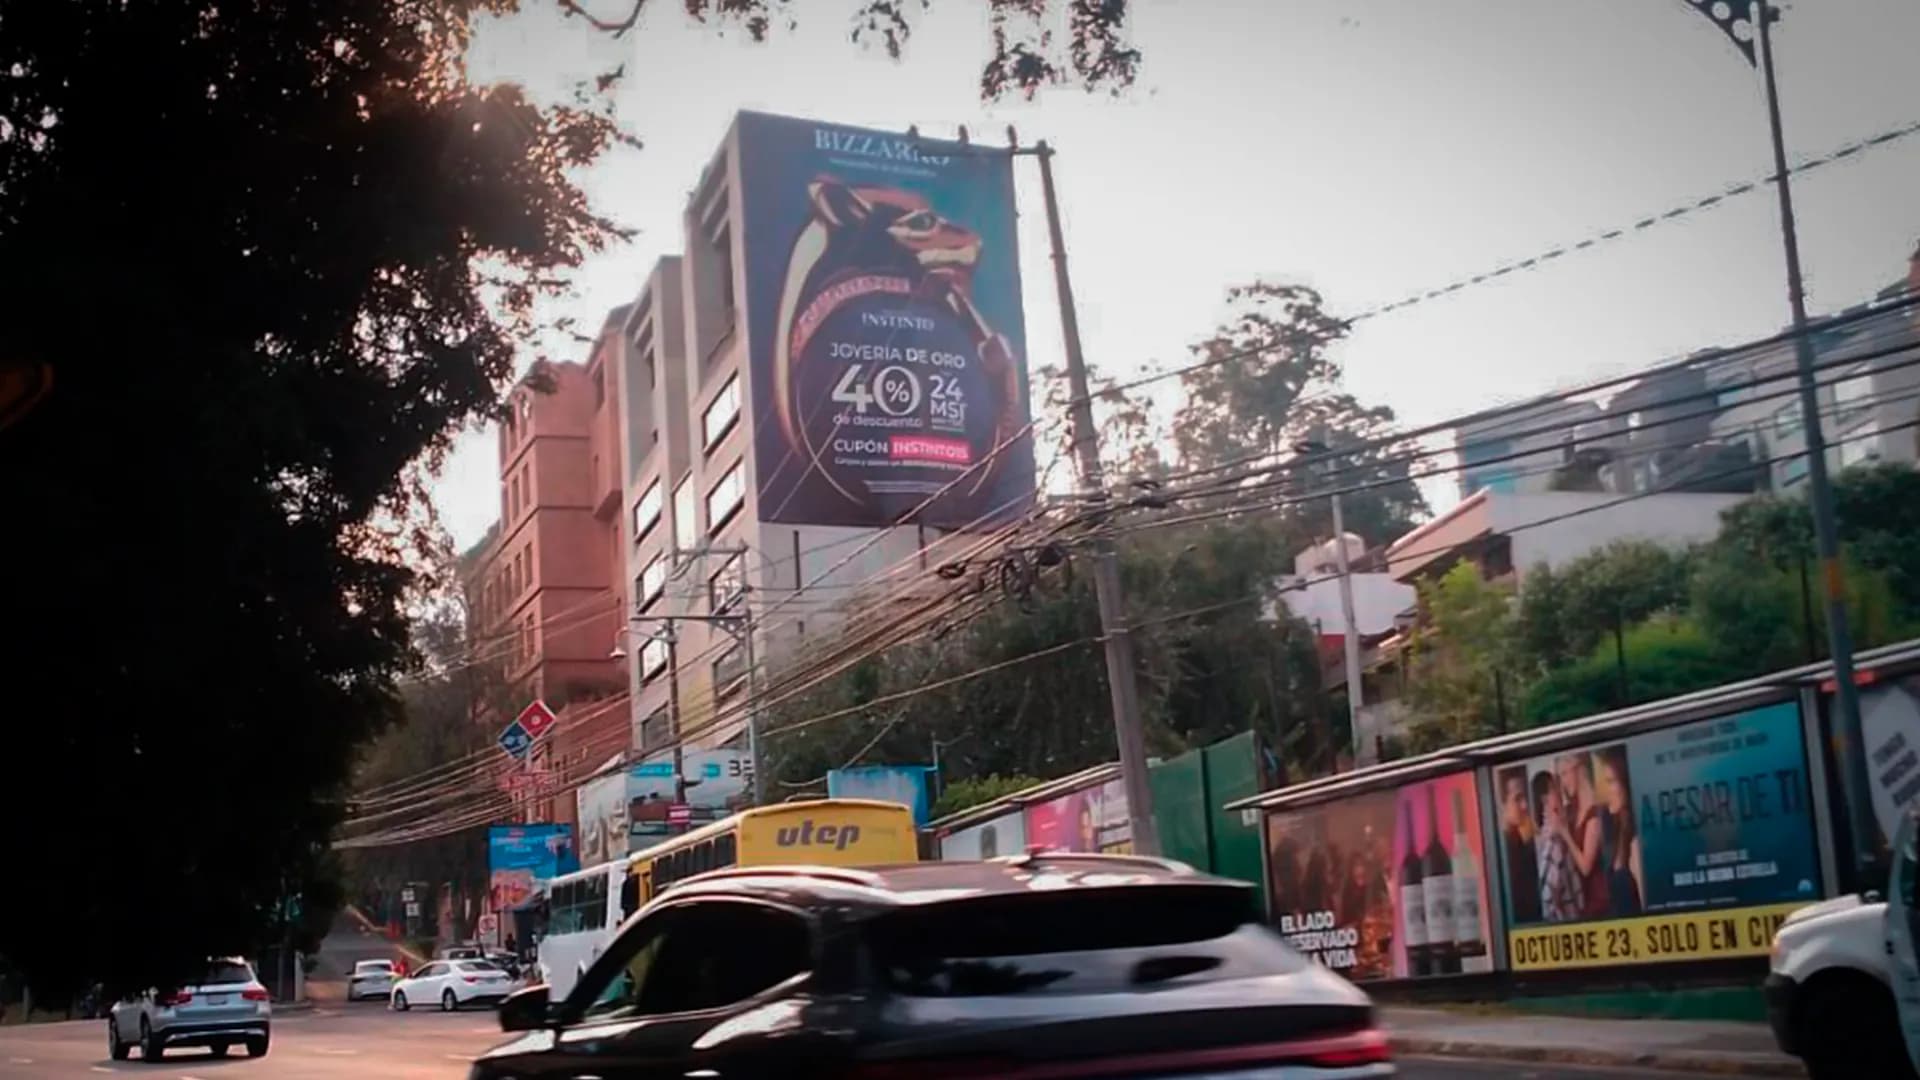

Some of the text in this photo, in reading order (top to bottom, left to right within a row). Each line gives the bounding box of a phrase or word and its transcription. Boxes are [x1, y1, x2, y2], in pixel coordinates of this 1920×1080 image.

[905, 347, 928, 364] DE
[931, 351, 966, 369] ORO
[929, 375, 963, 401] 24
[852, 416, 922, 428] descuento
[1660, 780, 1739, 832] PESAR
[1737, 771, 1771, 823] DE
[777, 820, 860, 851] utep
[1297, 910, 1335, 931] LADO
[1515, 930, 1599, 964] OCTUBRE
[1606, 928, 1638, 959] 23,
[1647, 922, 1698, 954] SOLO
[1708, 919, 1738, 950] EN
[1322, 948, 1358, 969] VIDA
